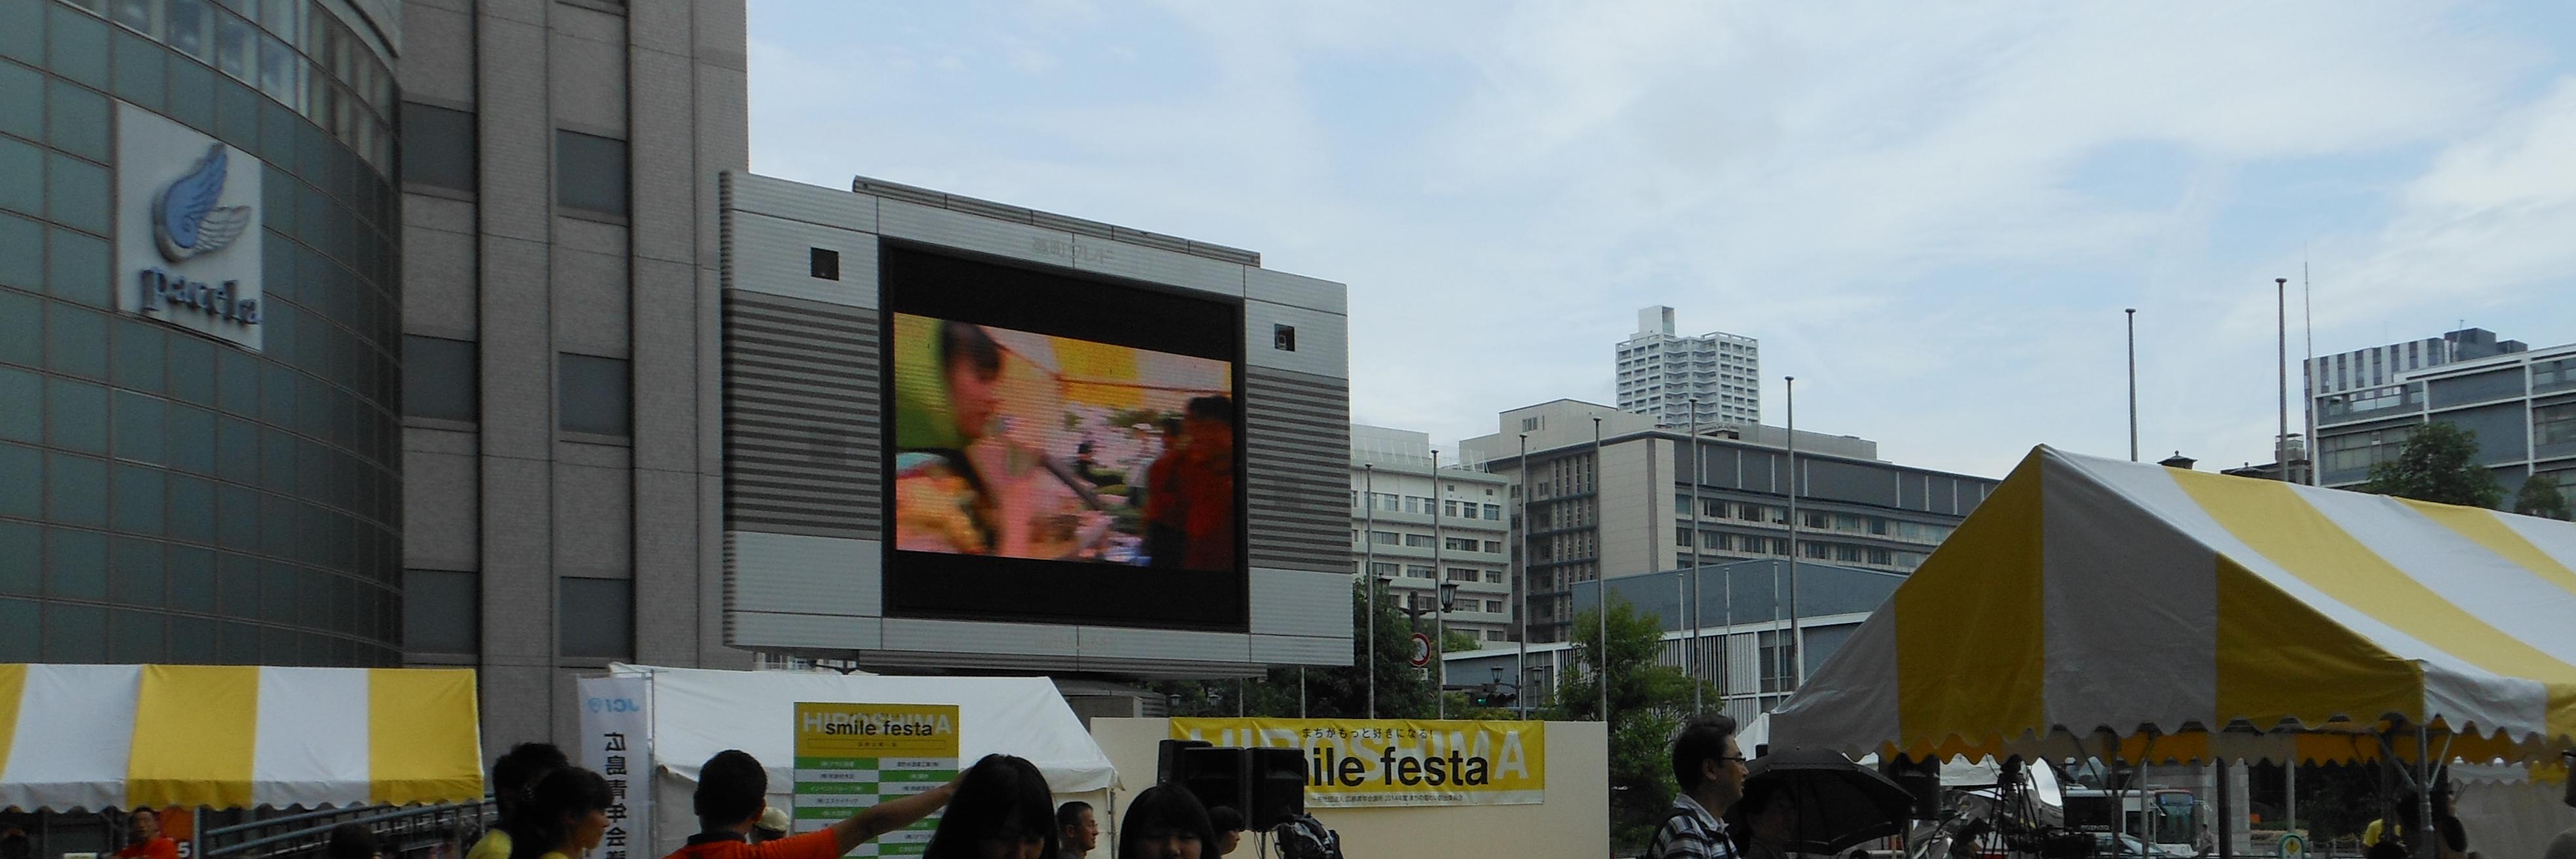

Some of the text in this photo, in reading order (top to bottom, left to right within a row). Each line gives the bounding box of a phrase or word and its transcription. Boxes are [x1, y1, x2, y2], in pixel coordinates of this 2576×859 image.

[825, 720, 933, 736] smile festa
[1302, 728, 1434, 739] まちがもっと好きになる!
[1304, 746, 1489, 787] ile festa
